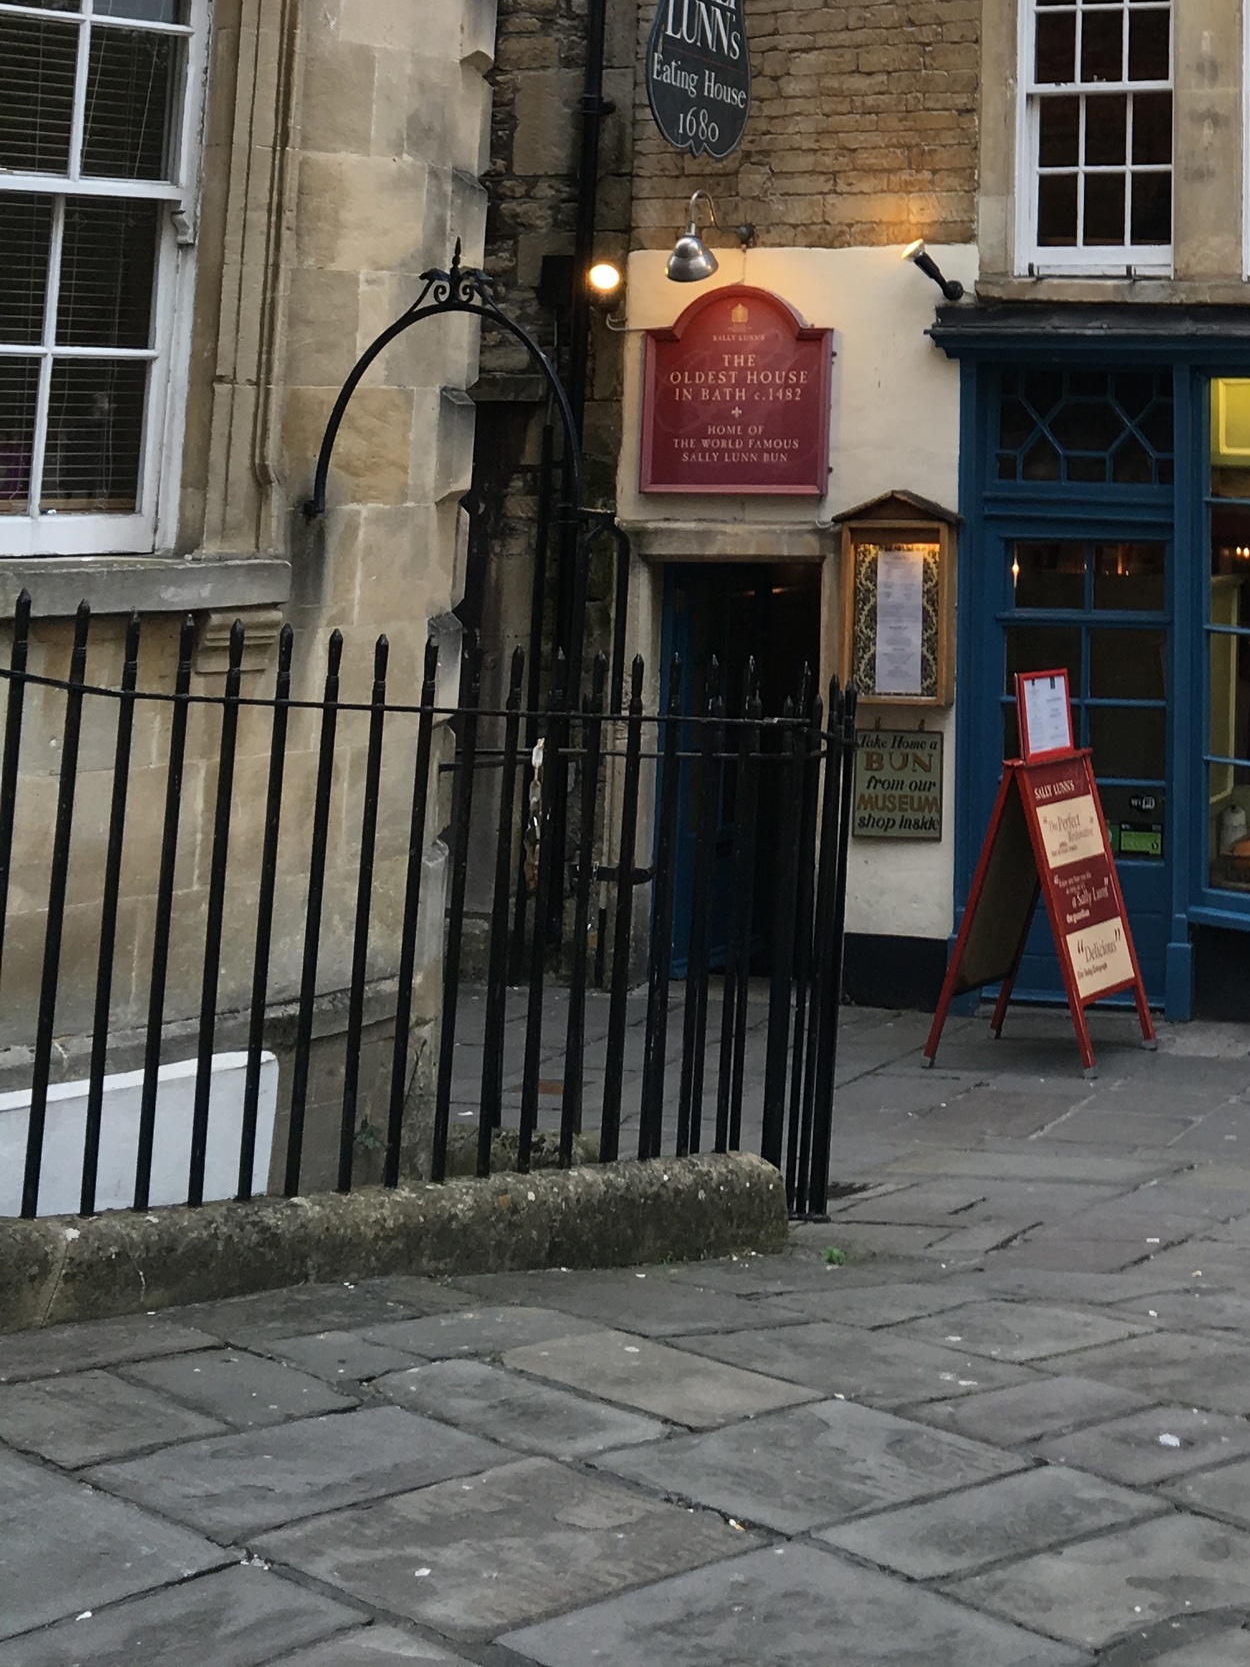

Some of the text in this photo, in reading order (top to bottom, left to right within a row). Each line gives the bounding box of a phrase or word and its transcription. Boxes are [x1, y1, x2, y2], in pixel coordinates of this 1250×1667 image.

[652, 52, 747, 109] Eating House
[679, 107, 719, 143] 1680
[722, 354, 756, 367] THE
[669, 370, 808, 384] OLDEST HOUSE
[674, 387, 802, 401] IN BATH c.1482
[708, 425, 765, 435] HOME OF
[673, 438, 799, 449] THE WORLD FAMOUS
[682, 452, 788, 463] SALLY LUNN BUN
[860, 734, 938, 750] Take Home a
[864, 750, 933, 773] BUN
[866, 775, 936, 792] from our
[1034, 784, 1053, 801] SALLY
[857, 794, 940, 813] MUSEUM
[858, 814, 896, 832] shop
